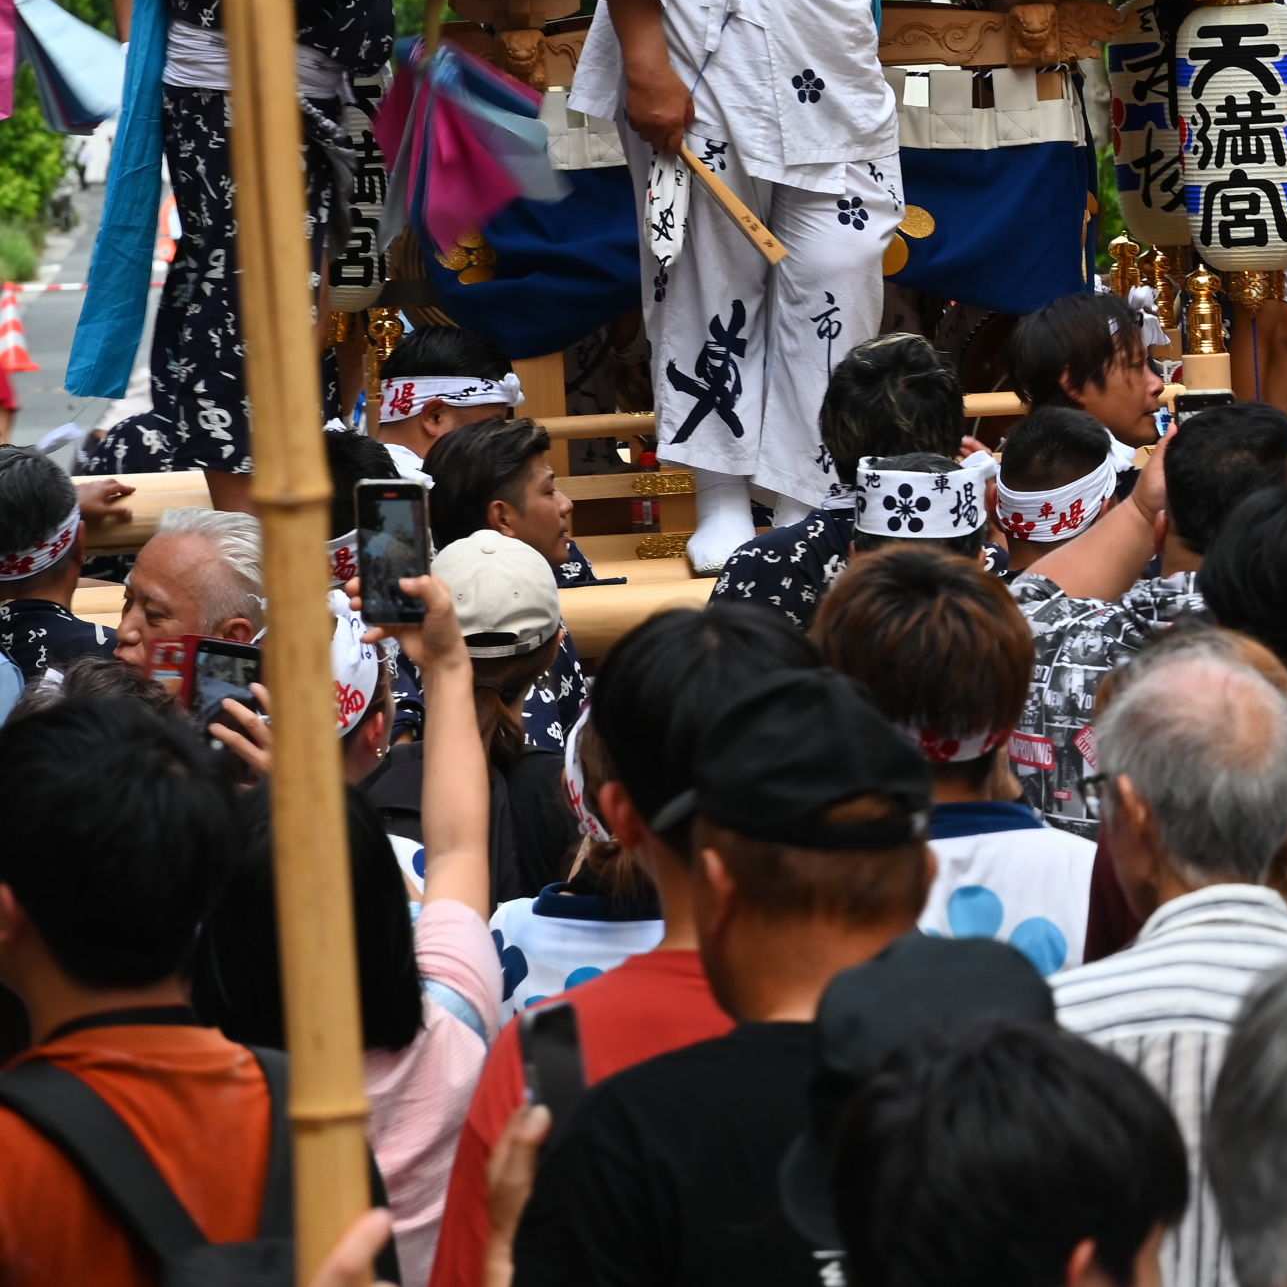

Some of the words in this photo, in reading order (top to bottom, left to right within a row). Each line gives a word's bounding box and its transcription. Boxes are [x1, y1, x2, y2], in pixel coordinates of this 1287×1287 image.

[932, 474, 950, 493] 車
[950, 482, 979, 528] 場
[1038, 502, 1055, 520] 車
